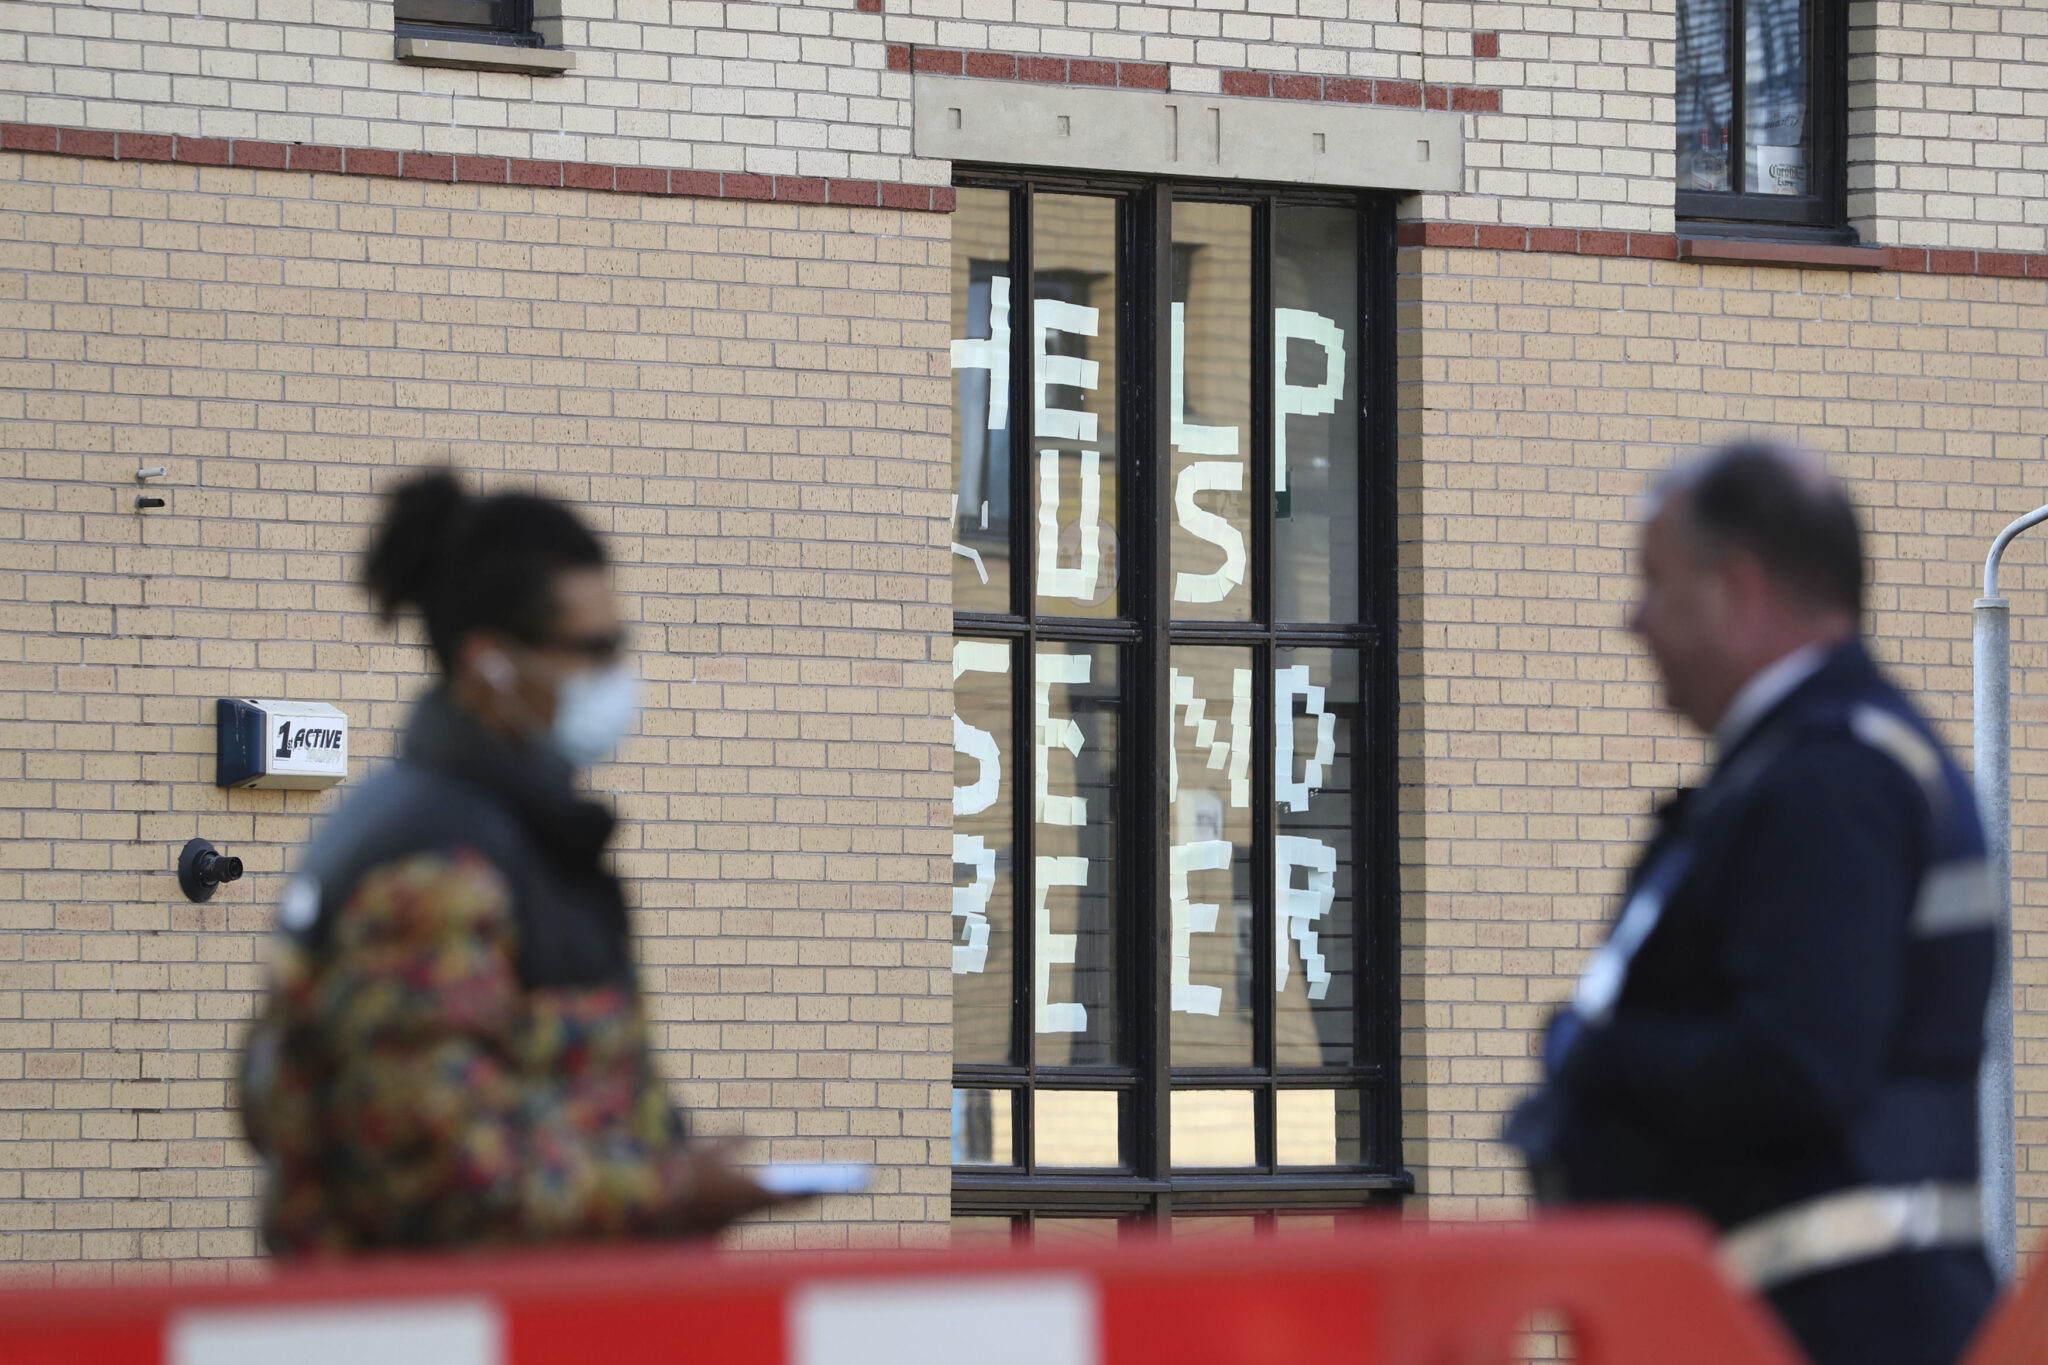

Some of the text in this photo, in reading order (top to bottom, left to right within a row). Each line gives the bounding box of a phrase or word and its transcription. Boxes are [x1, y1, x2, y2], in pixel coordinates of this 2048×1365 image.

[951, 276, 1345, 491] HELP
[1037, 450, 1246, 602] US
[294, 728, 342, 749] ACTIVE
[952, 641, 1336, 825] SEND
[952, 834, 1336, 1033] BEER
